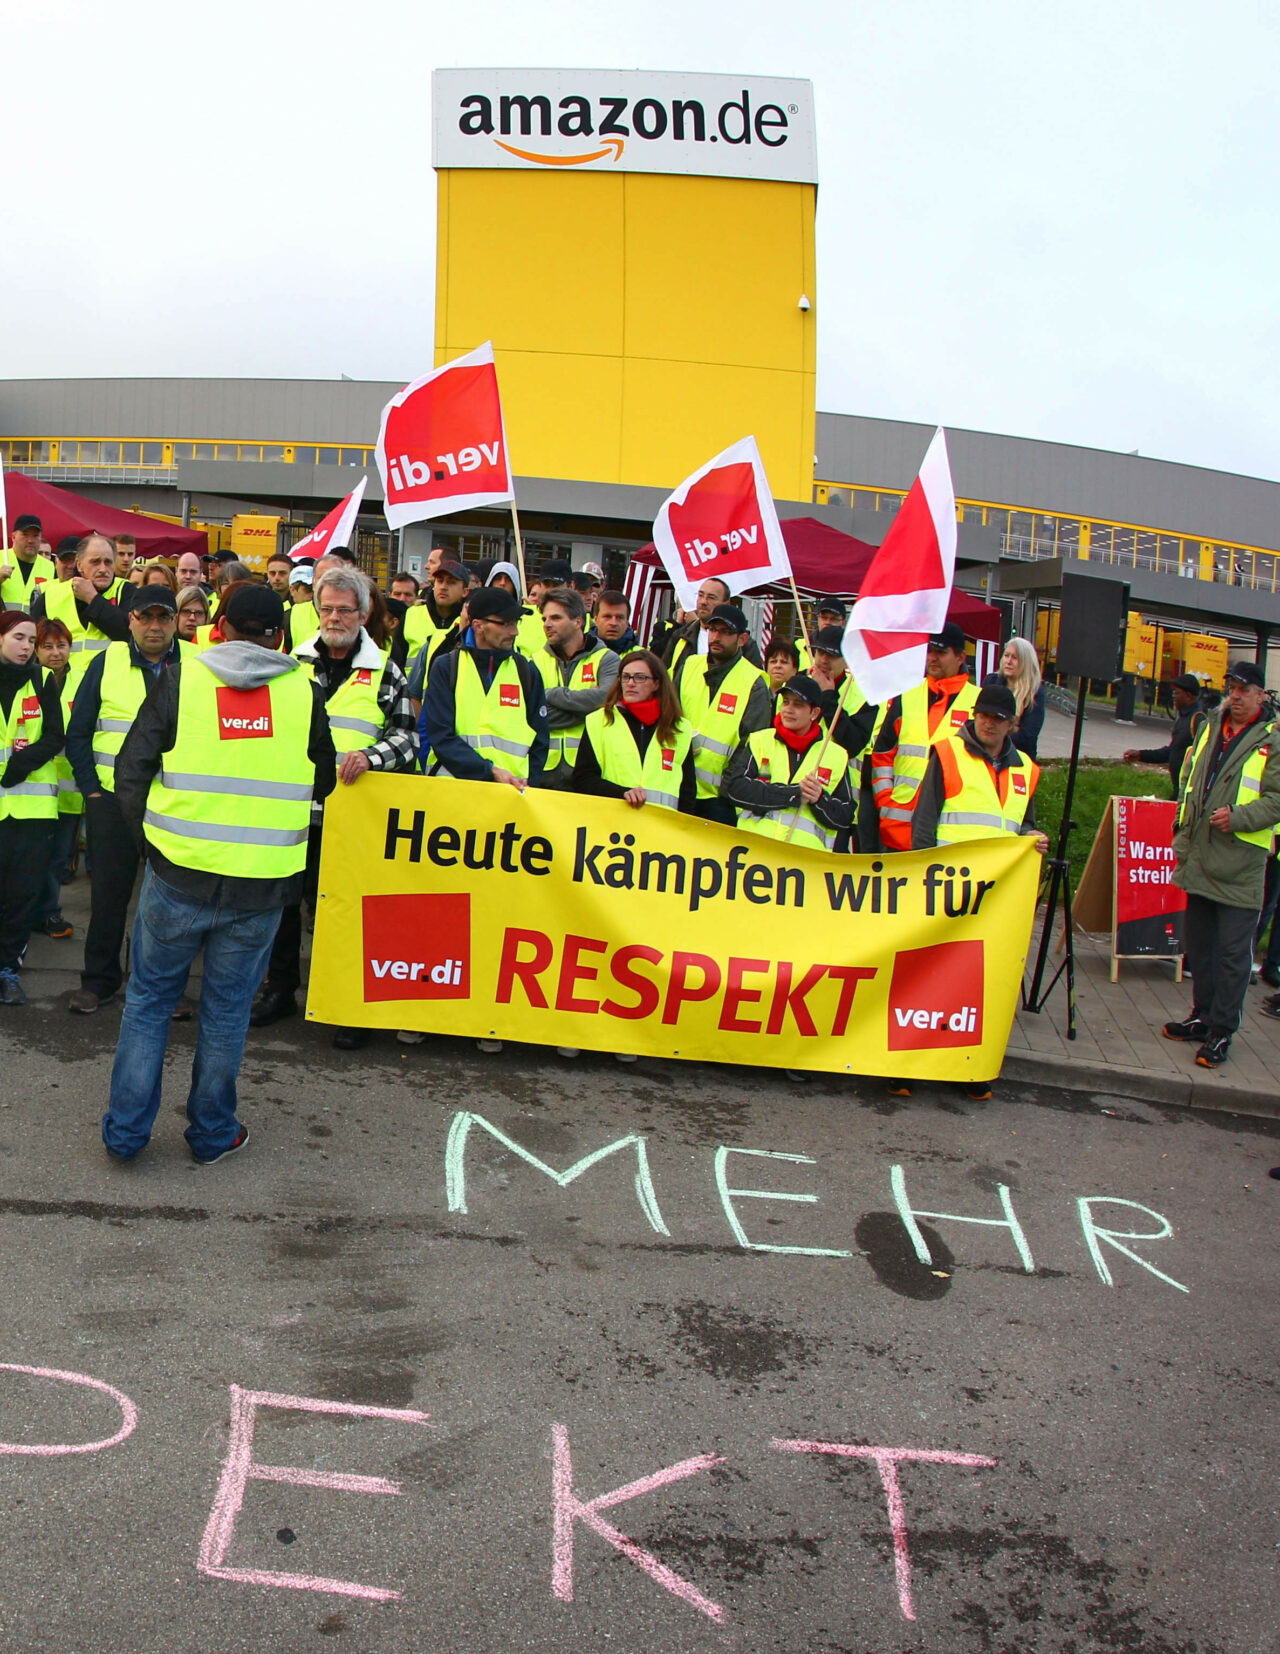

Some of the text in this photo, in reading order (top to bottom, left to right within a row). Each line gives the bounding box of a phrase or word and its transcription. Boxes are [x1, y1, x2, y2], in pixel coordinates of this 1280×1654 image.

[459, 90, 788, 147] amazon.de
[221, 716, 269, 731] ver.di
[383, 808, 995, 918] Heute kämpfen wir für
[370, 959, 463, 986] ver.di
[495, 927, 878, 1037] RESPEKT
[894, 1006, 977, 1032] ver.di
[445, 1111, 1189, 1293] MEHR
